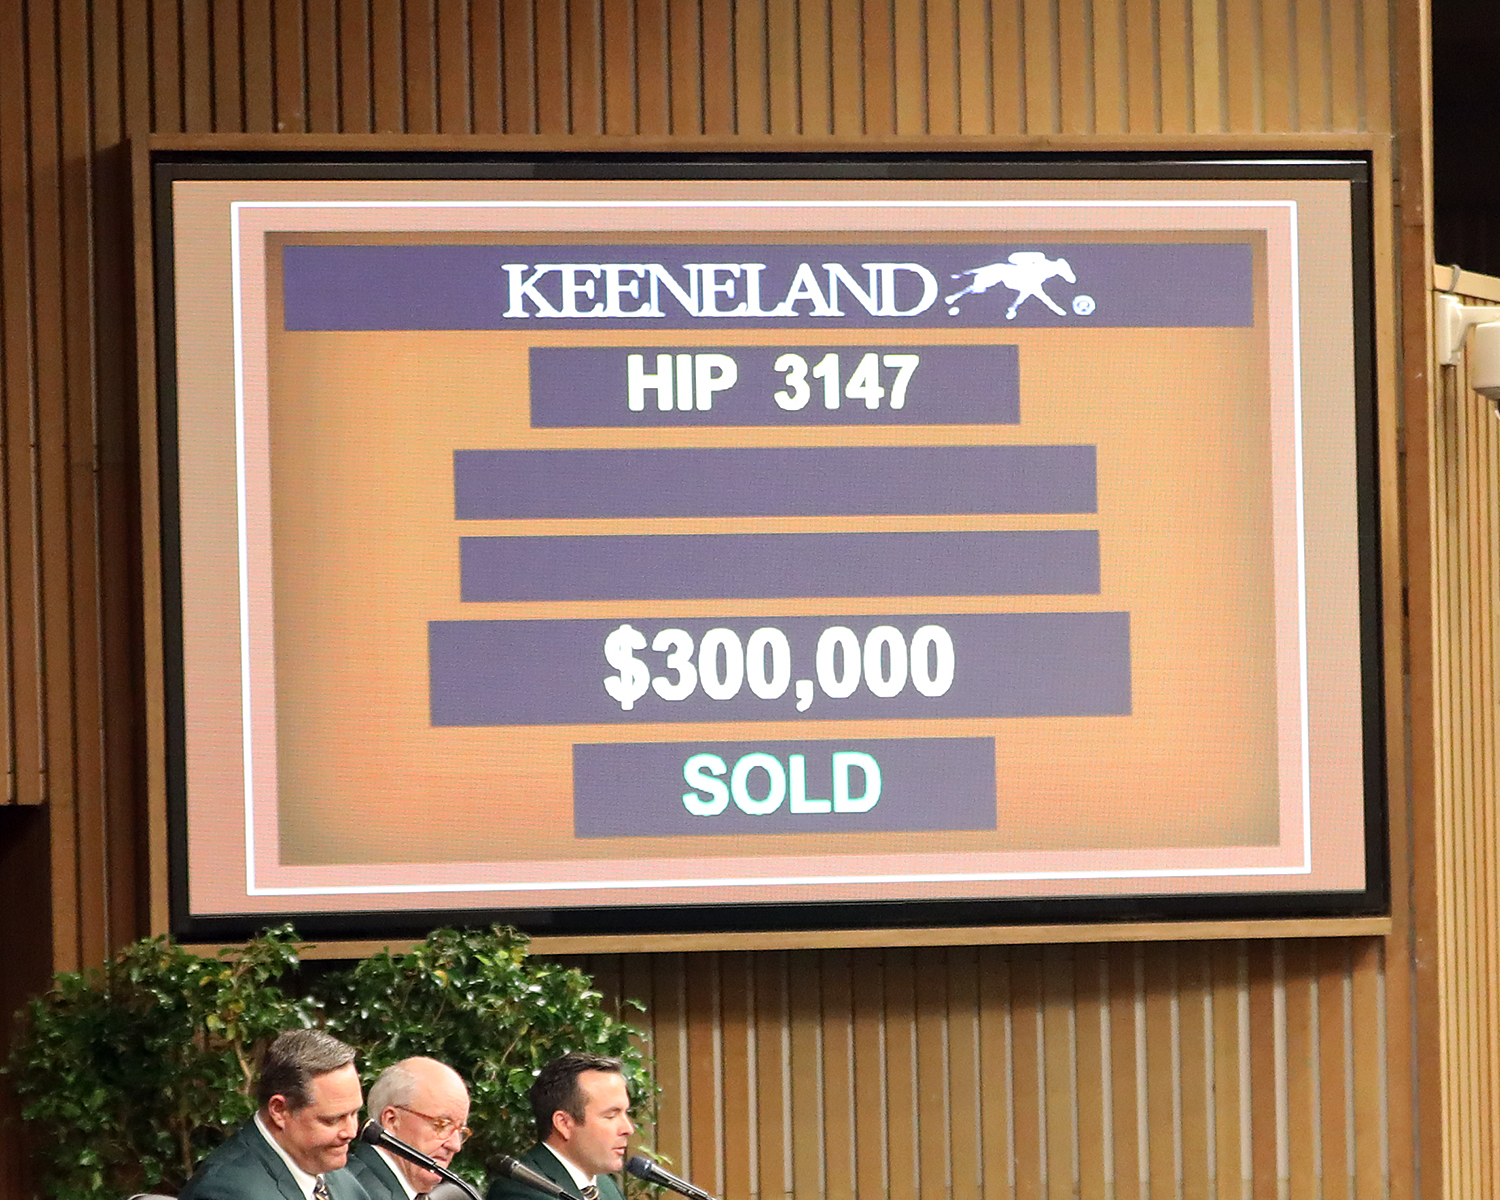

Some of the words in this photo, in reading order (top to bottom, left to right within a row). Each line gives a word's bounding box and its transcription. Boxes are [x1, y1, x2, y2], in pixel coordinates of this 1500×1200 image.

[501, 262, 939, 318] KEENELAND
[626, 353, 739, 411] HIP
[773, 352, 921, 411] 3147
[603, 623, 956, 712] $300,000
[682, 751, 883, 817] SOLD
